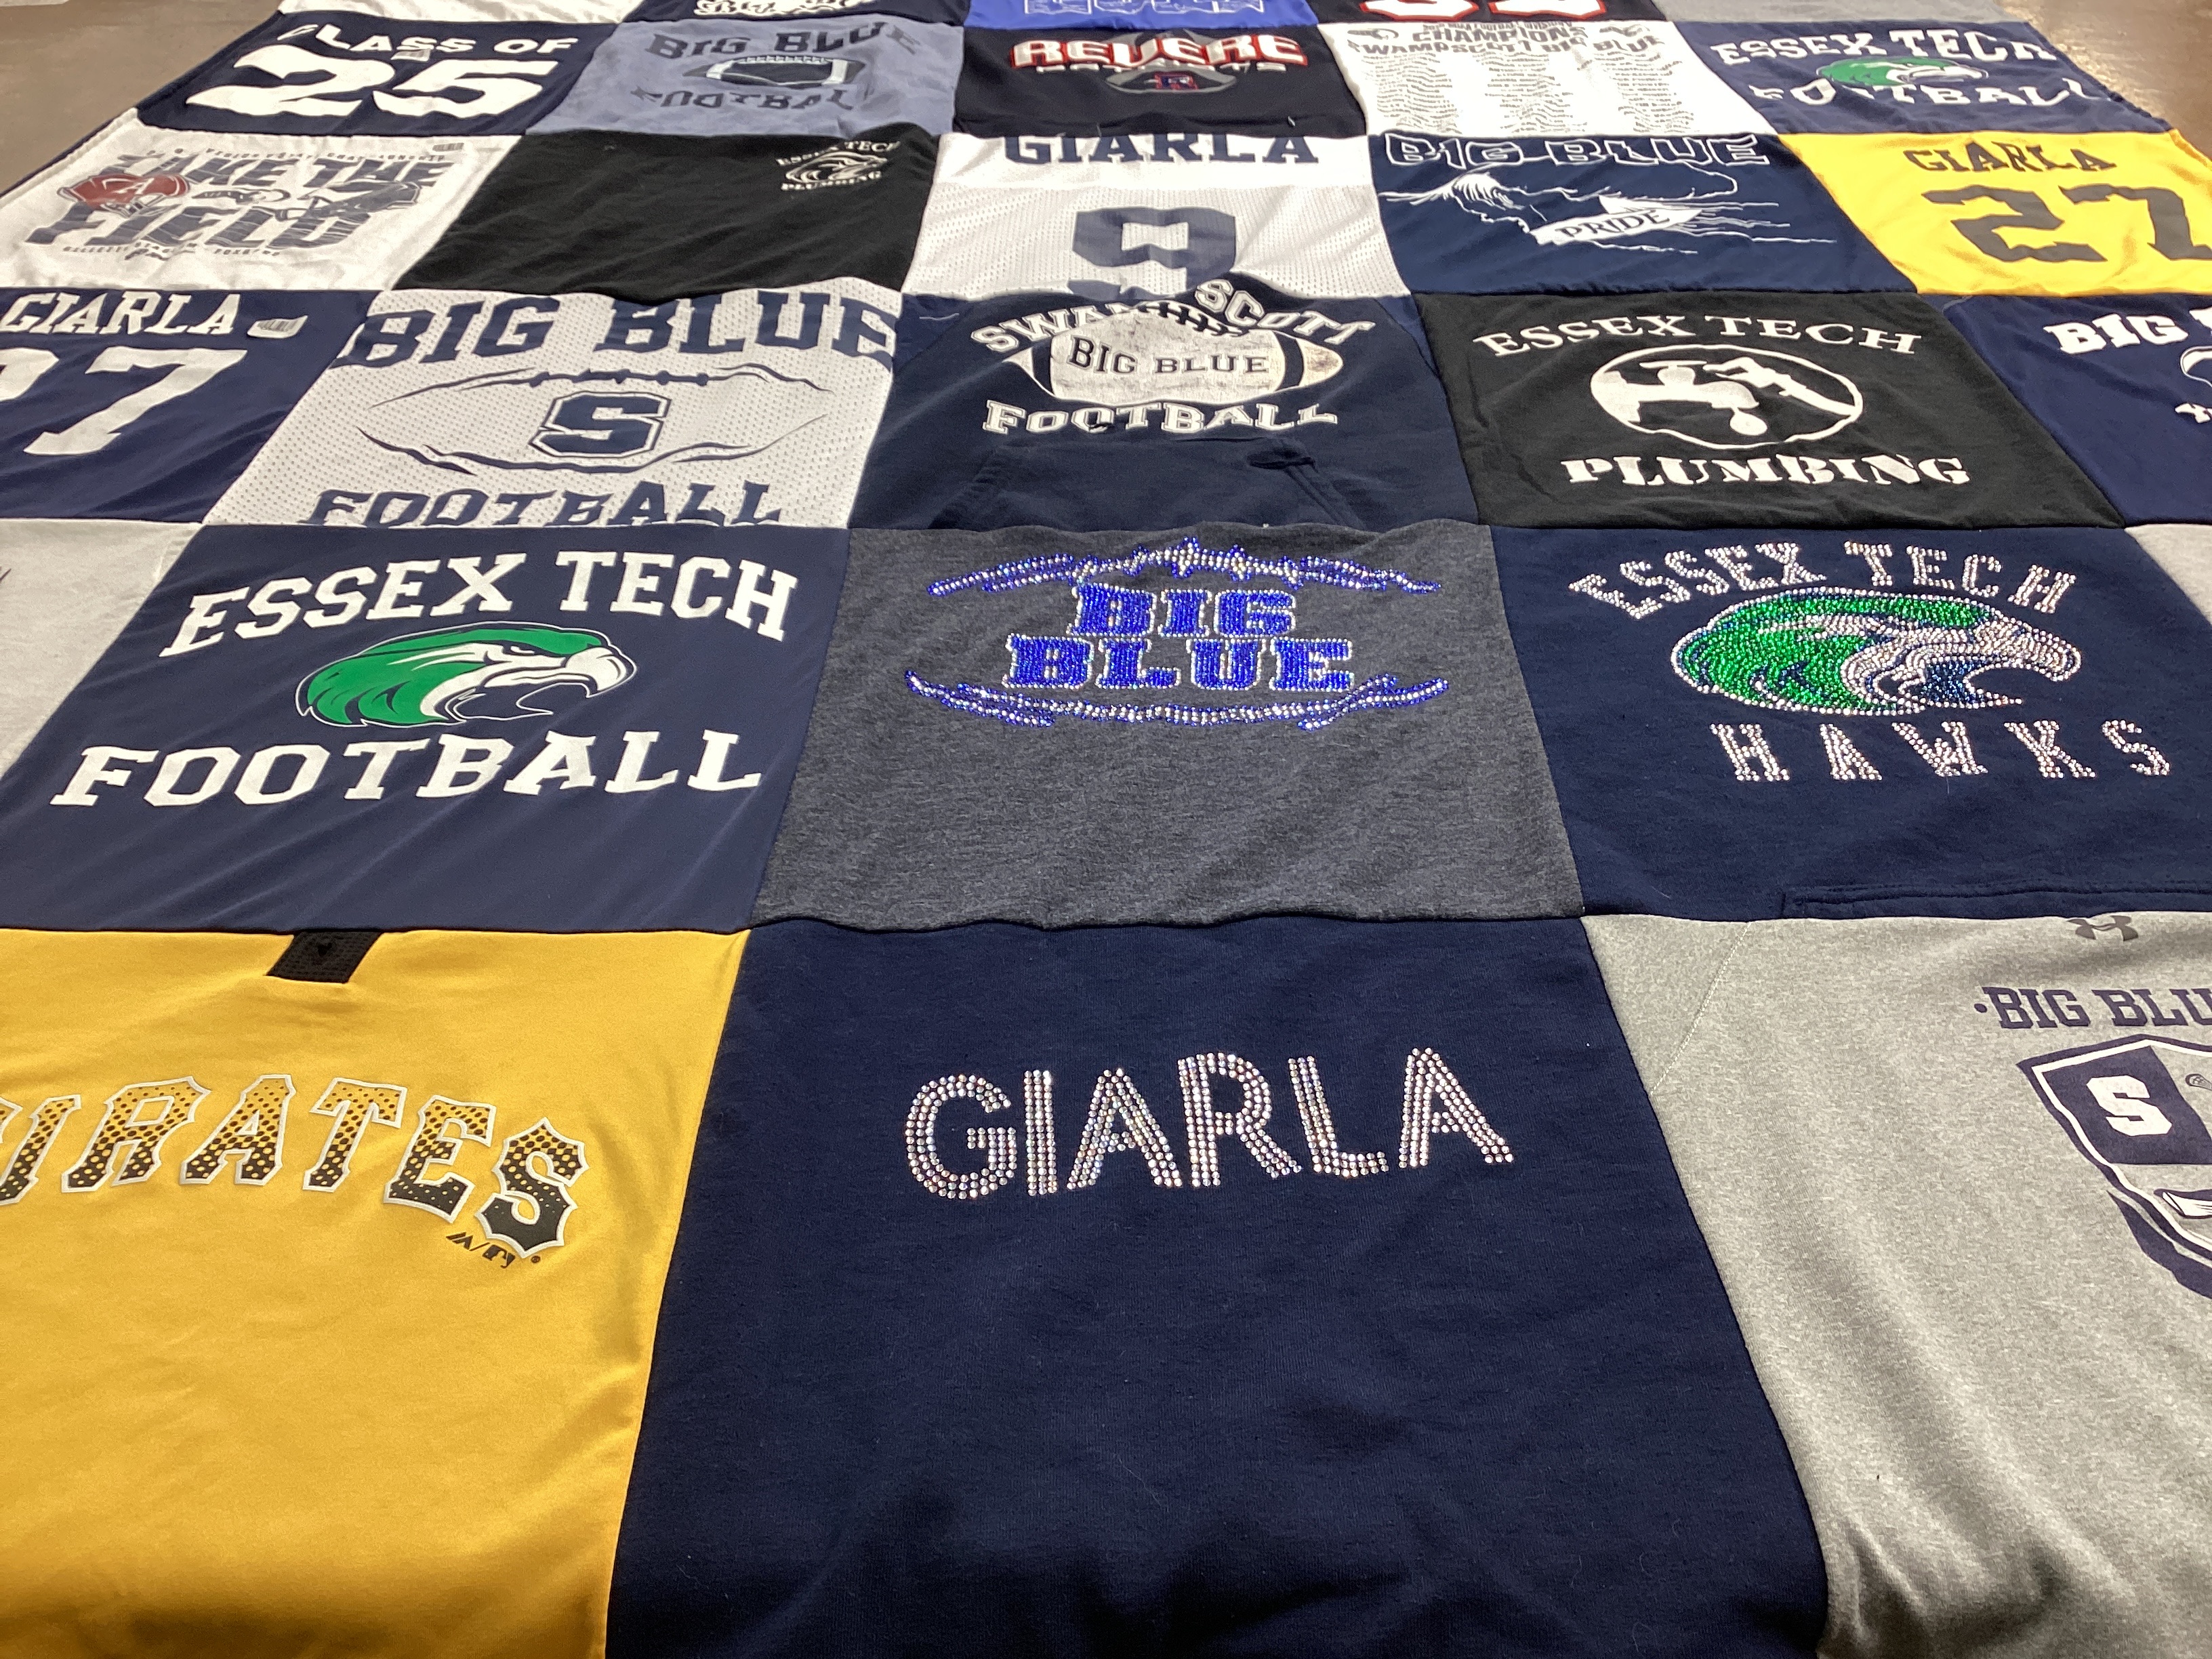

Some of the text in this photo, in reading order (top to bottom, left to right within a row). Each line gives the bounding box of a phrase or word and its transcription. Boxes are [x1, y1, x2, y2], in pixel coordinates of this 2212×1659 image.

[276, 24, 579, 54] CLASS OF
[644, 22, 922, 58] BIG BLUE
[1010, 34, 1309, 68] REVERE
[1412, 26, 1588, 43] CHAMPIONS
[1710, 32, 1887, 65] ESSEX
[186, 45, 558, 119] 25
[630, 85, 854, 111] FOOTBAL
[1004, 134, 1319, 164] GIARLA
[1385, 134, 1769, 168] BIG BLUE
[1903, 141, 2116, 173] GIARLA
[304, 157, 454, 187] THE
[24, 203, 371, 249] FIELD
[1557, 209, 1673, 237] PRIDE
[1921, 184, 2212, 262] 27
[1, 292, 241, 335] GIARLA
[328, 291, 897, 373] BIG BLUE
[970, 279, 1376, 351] SWASCOTT
[2043, 312, 2189, 356] BIG
[1068, 334, 1271, 375] BIG BLUE
[1472, 314, 1922, 358] ESSEX TECH
[982, 400, 1338, 434] FOOTBALL
[1560, 453, 1971, 487] PLUMBING
[298, 480, 782, 528] FOOTBALL
[1568, 540, 2076, 620] ESSEX TECH
[159, 551, 798, 657] ESSEX TECH
[1067, 581, 1297, 638] BIG
[1002, 634, 1355, 691] BLUE
[50, 729, 762, 806] FOOTBALL
[1710, 720, 2170, 781] HAWKS
[1982, 987, 2091, 1029] BIG
[905, 1046, 1516, 1200] GIARLA
